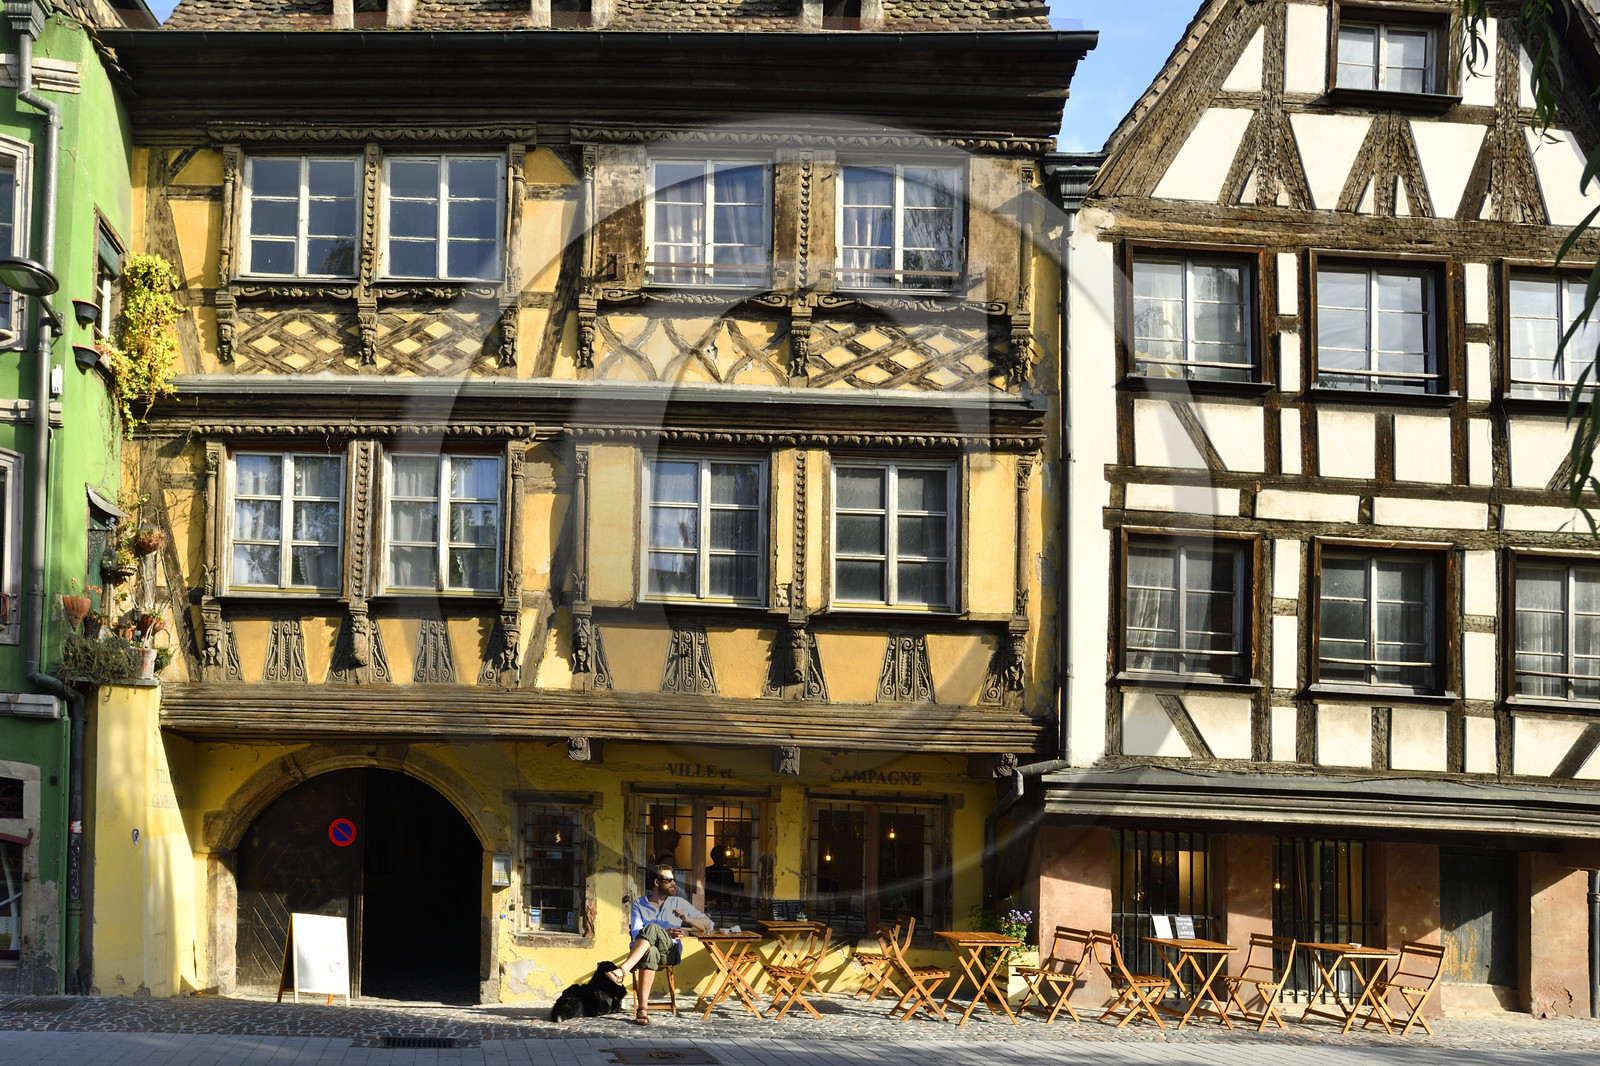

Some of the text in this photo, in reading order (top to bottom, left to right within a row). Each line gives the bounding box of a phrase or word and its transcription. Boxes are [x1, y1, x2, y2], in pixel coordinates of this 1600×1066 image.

[668, 763, 733, 779] VILLE et
[829, 769, 922, 786] CAMPAGNE
